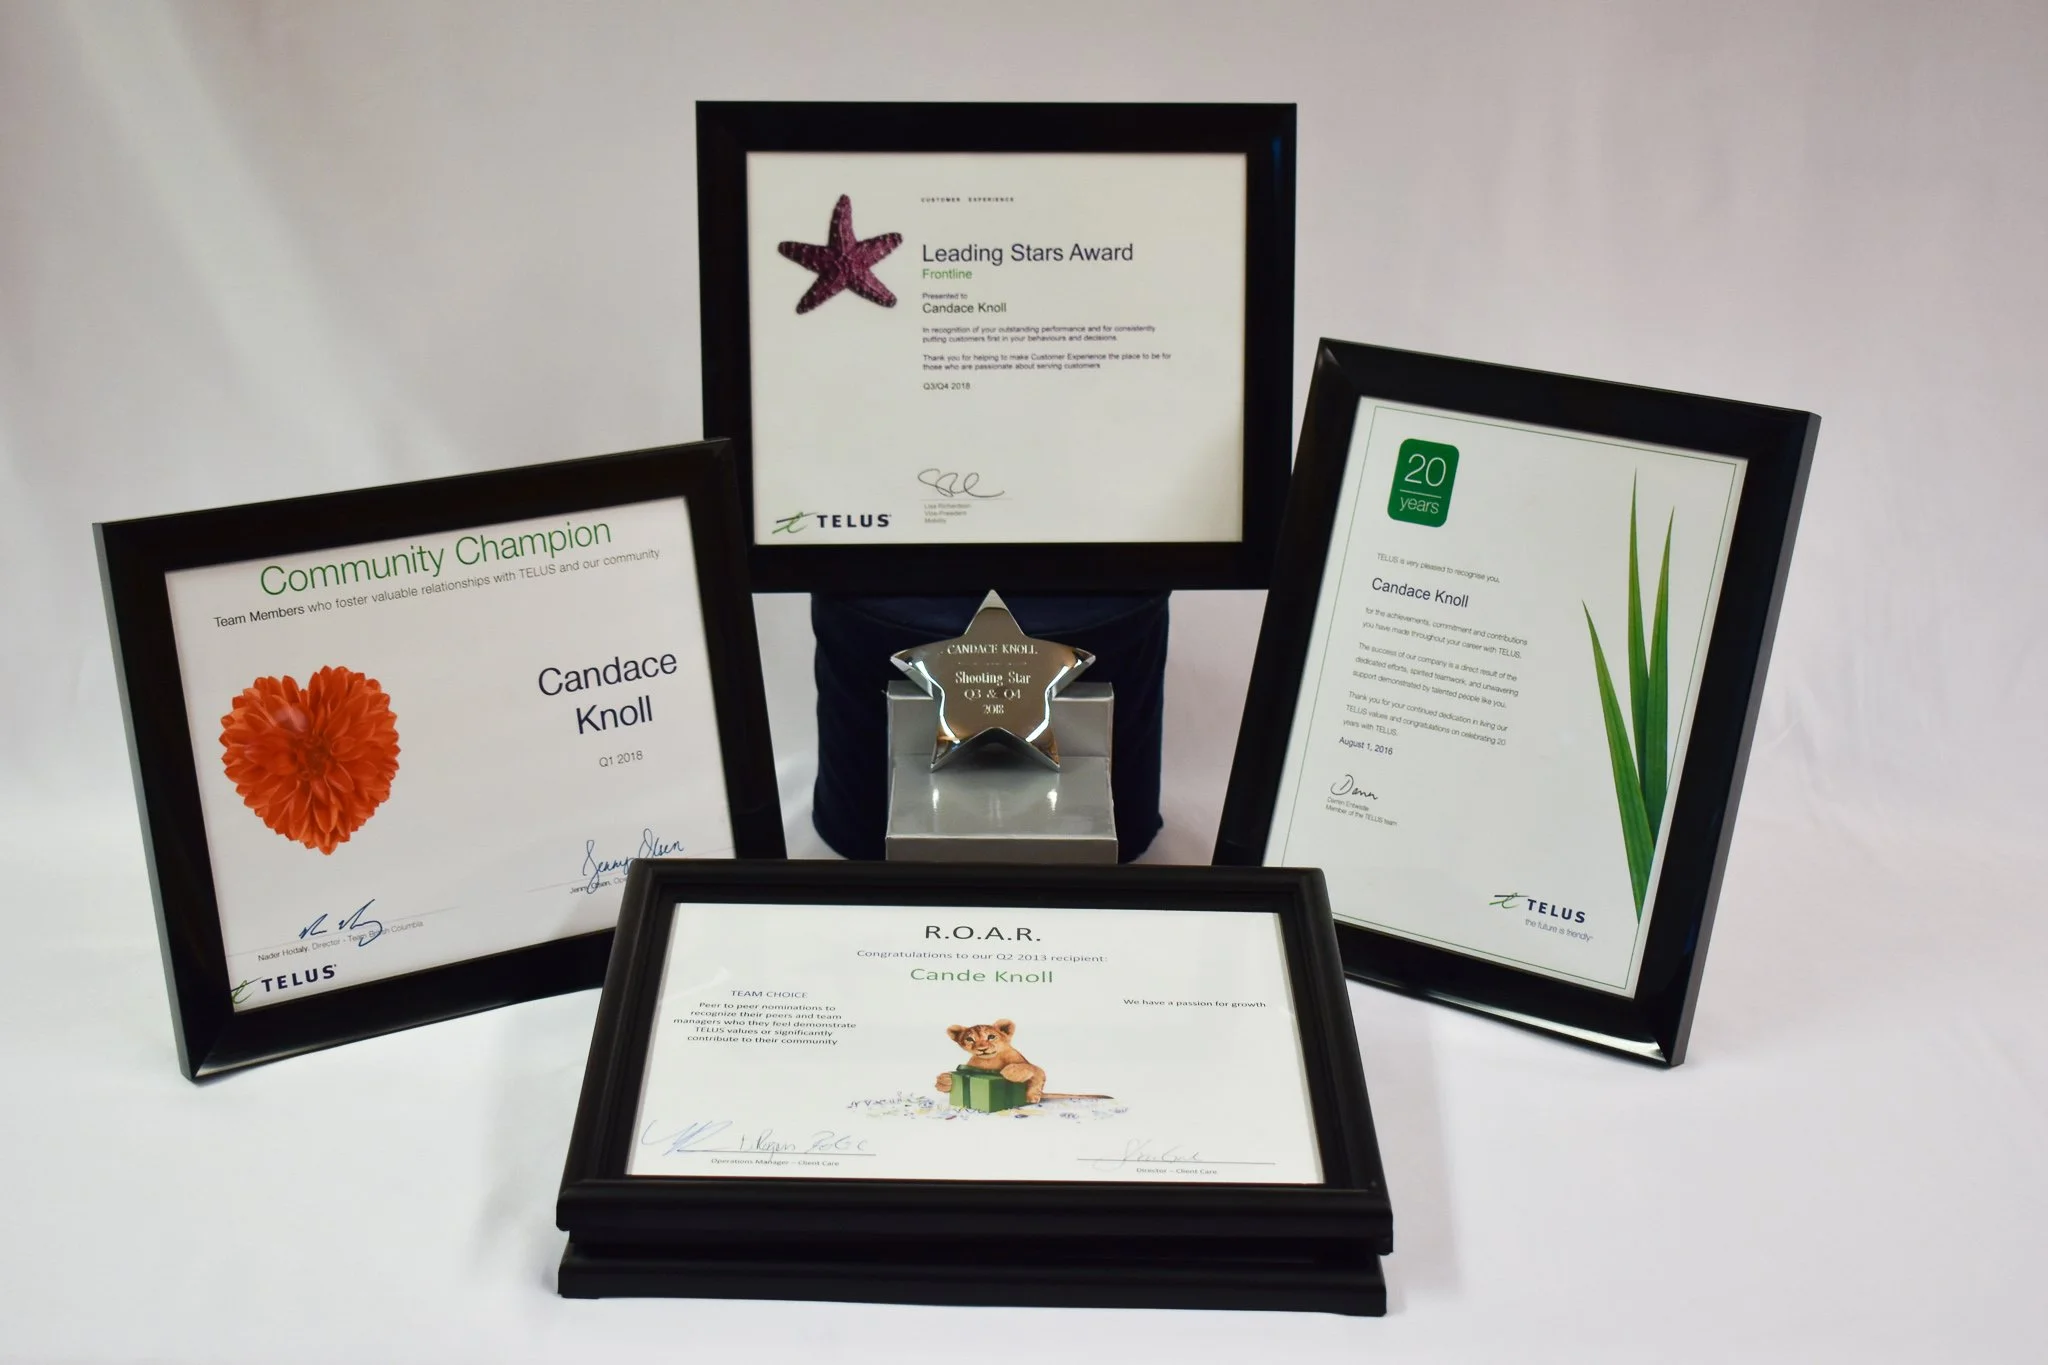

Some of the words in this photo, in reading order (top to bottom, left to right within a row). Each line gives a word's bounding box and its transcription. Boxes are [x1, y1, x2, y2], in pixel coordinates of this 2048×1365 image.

[922, 243, 1003, 267] Leading
[1010, 243, 1064, 262] Stars
[1069, 243, 1133, 261] Award
[922, 268, 973, 280] Frontline
[921, 292, 959, 300] Presented
[922, 302, 974, 314] Candace
[977, 302, 1007, 313] Knoll
[930, 326, 971, 335] recognition
[972, 325, 980, 334] of
[980, 327, 997, 335] your
[998, 326, 1040, 335] outstanding
[1041, 325, 1086, 334] performance
[1102, 324, 1113, 333] for
[1113, 325, 1156, 333] consistently
[922, 335, 947, 344] putting
[986, 334, 1000, 342] first
[1010, 335, 1026, 343] your
[1068, 334, 1082, 342] and
[922, 382, 949, 390] Q3/Q4
[951, 382, 971, 390] 2018
[1404, 453, 1447, 487] 20
[1399, 496, 1440, 514] years
[816, 513, 889, 528] TELUS
[260, 544, 444, 596] Community
[455, 521, 611, 566] Champion
[1377, 552, 1399, 564] TELUS
[1406, 560, 1420, 569] very
[1419, 562, 1446, 573] pleased
[1454, 569, 1486, 580] recognise
[1486, 575, 1500, 584] you,
[213, 615, 247, 628] Team
[249, 606, 305, 622] Members
[306, 601, 332, 613] who
[335, 595, 368, 609] foster
[371, 587, 418, 603] valuable
[421, 576, 491, 595] relationships
[492, 571, 516, 583] with
[518, 563, 557, 579] TELUS
[559, 560, 580, 573] and
[582, 559, 600, 569] our
[602, 549, 660, 566] community
[1371, 577, 1431, 601] Candace
[1434, 589, 1469, 608] Knoll
[1365, 607, 1374, 615] for
[1374, 608, 1386, 618] the
[1386, 612, 1431, 626] achievements,
[1432, 622, 1473, 635] commitment
[1472, 629, 1486, 638] and
[1486, 632, 1528, 646] contributions
[1362, 621, 1375, 629] you
[1374, 622, 1391, 632] have
[1391, 627, 1410, 636] made
[1411, 630, 1446, 644] throughout
[1446, 638, 1461, 646] your
[1461, 642, 1483, 650] career
[1482, 646, 1497, 654] with
[1498, 647, 1522, 659] TELUS.
[946, 643, 998, 655] CANDACE
[1002, 644, 1038, 654] KNOLL
[538, 653, 677, 696] Candace
[955, 671, 1004, 686] Shooting
[1008, 671, 1031, 684] Star
[963, 689, 982, 701] Q3
[986, 689, 997, 699] &
[1003, 688, 1021, 700] Q4
[575, 694, 653, 735] Knoll
[983, 704, 1005, 714] 2018
[1343, 719, 1360, 728] years
[1360, 723, 1374, 731] with
[1375, 724, 1398, 737] TELUS.
[1338, 736, 1365, 749] August
[1366, 742, 1373, 752] 1,
[1374, 744, 1393, 756] 2016
[598, 756, 613, 768] Q1
[616, 750, 643, 765] 2018
[1527, 898, 1586, 924] TELUS
[925, 925, 1041, 942] R.O.A.R.
[855, 949, 954, 960] Congratulations
[955, 951, 970, 960] to
[970, 953, 994, 961] our
[995, 952, 1014, 962] Q2
[1016, 952, 1048, 962] 2013
[1049, 954, 1108, 964] recipient:
[260, 964, 337, 993] TELUS
[910, 968, 986, 982] Cande
[995, 970, 1053, 983] Knoll
[731, 989, 764, 998] TEAM
[764, 990, 808, 999] CHOICE
[698, 1001, 721, 1009] Peer
[723, 1002, 735, 1010] to
[735, 1003, 759, 1011] peer
[760, 1003, 824, 1012] nominations
[1122, 998, 1141, 1006] We
[1141, 998, 1166, 1006] have
[1175, 1000, 1214, 1008] passion
[1214, 999, 1229, 1008] for
[1230, 1000, 1267, 1009] growth
[689, 1010, 738, 1018] recognize
[738, 1010, 763, 1019] their
[764, 1012, 794, 1020] peers
[794, 1012, 815, 1020] and
[815, 1012, 843, 1021] team
[672, 1018, 722, 1026] managers
[722, 1018, 747, 1027] who
[747, 1019, 771, 1028] they
[771, 1019, 792, 1028] feel
[792, 1020, 858, 1029] demonstrate
[695, 1025, 726, 1034] TELUS
[726, 1026, 760, 1036] values
[773, 1028, 834, 1038] significantly
[686, 1034, 740, 1043] contribute
[740, 1036, 753, 1044] to
[754, 1036, 778, 1044] their
[779, 1037, 839, 1047] community
[709, 1157, 755, 1166] Operations
[753, 1156, 790, 1167] Manager
[796, 1159, 821, 1167] Client
[820, 1160, 841, 1168] Care
